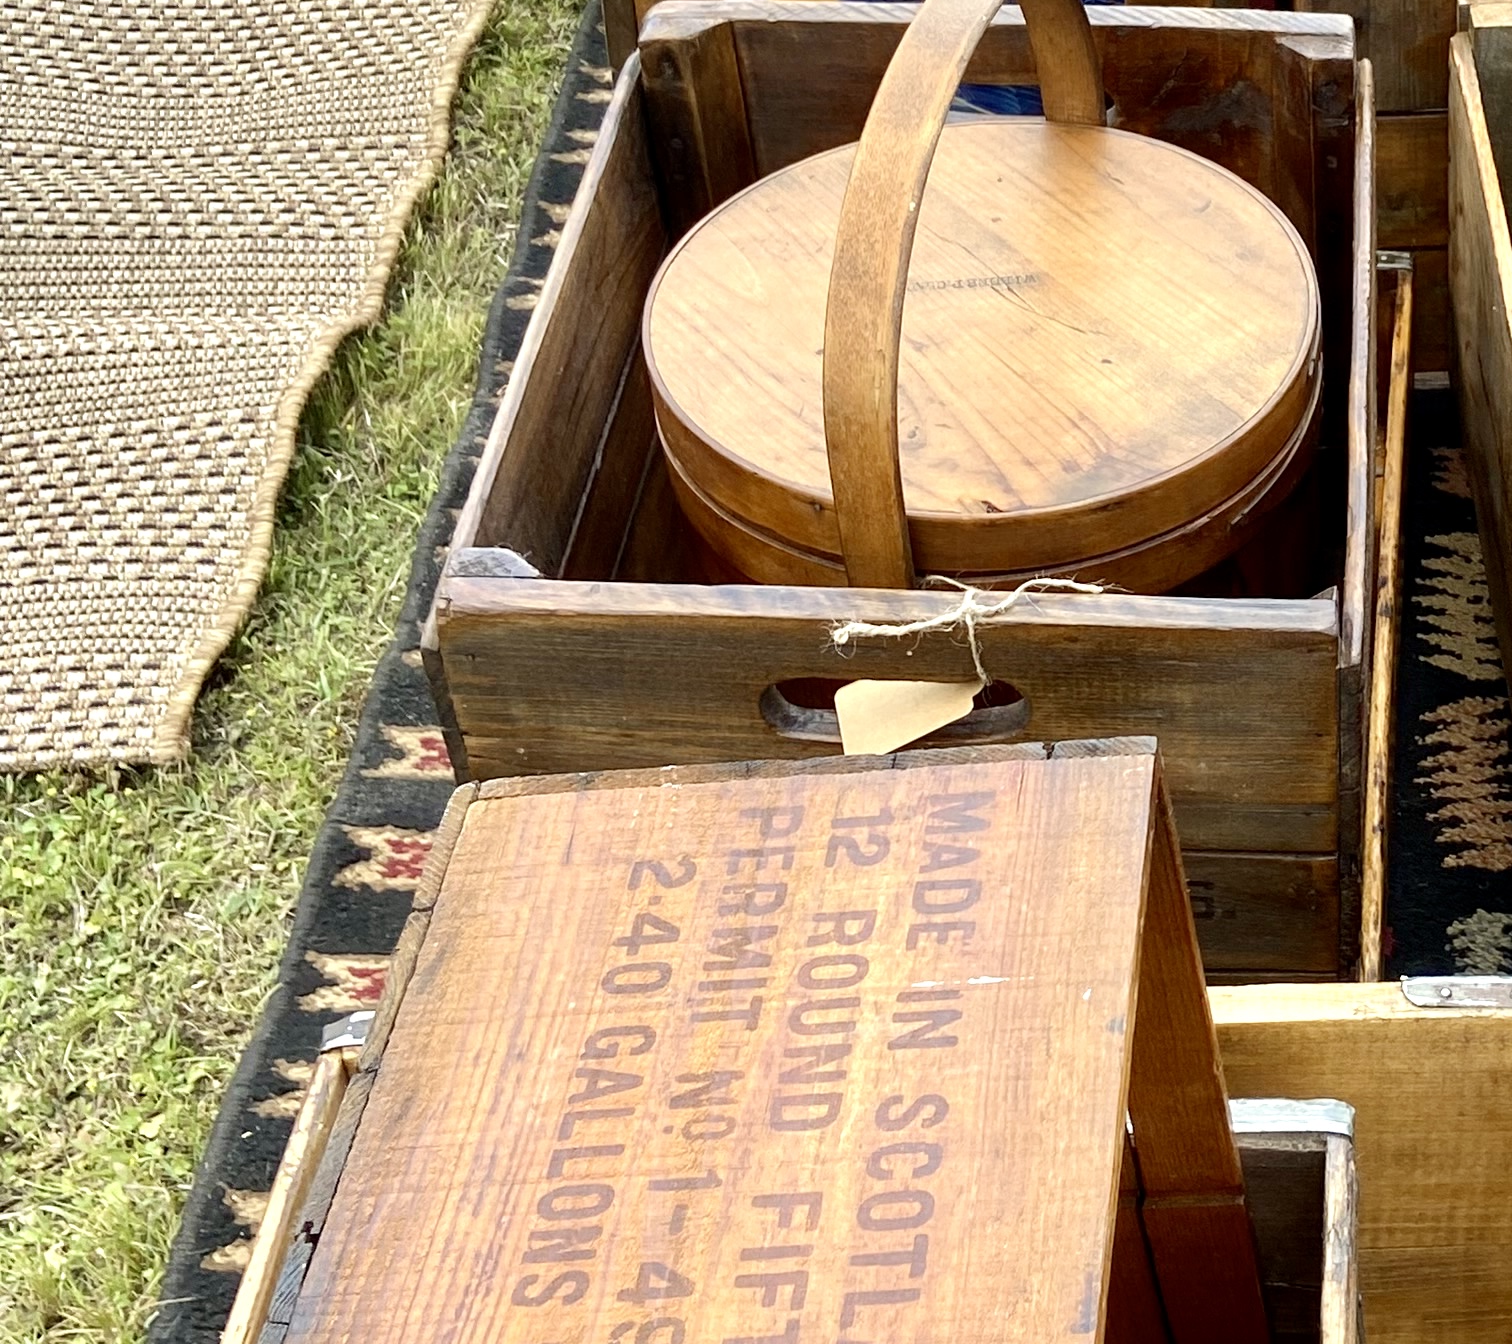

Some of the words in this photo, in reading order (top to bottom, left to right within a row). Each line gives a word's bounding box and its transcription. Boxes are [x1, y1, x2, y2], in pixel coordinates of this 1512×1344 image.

[690, 805, 805, 1033] PERMIT
[824, 807, 895, 869] 12
[906, 790, 996, 951] MADE
[770, 909, 878, 1133] ROUND
[887, 989, 964, 1051] IN
[511, 1024, 657, 1308] GALLONS
